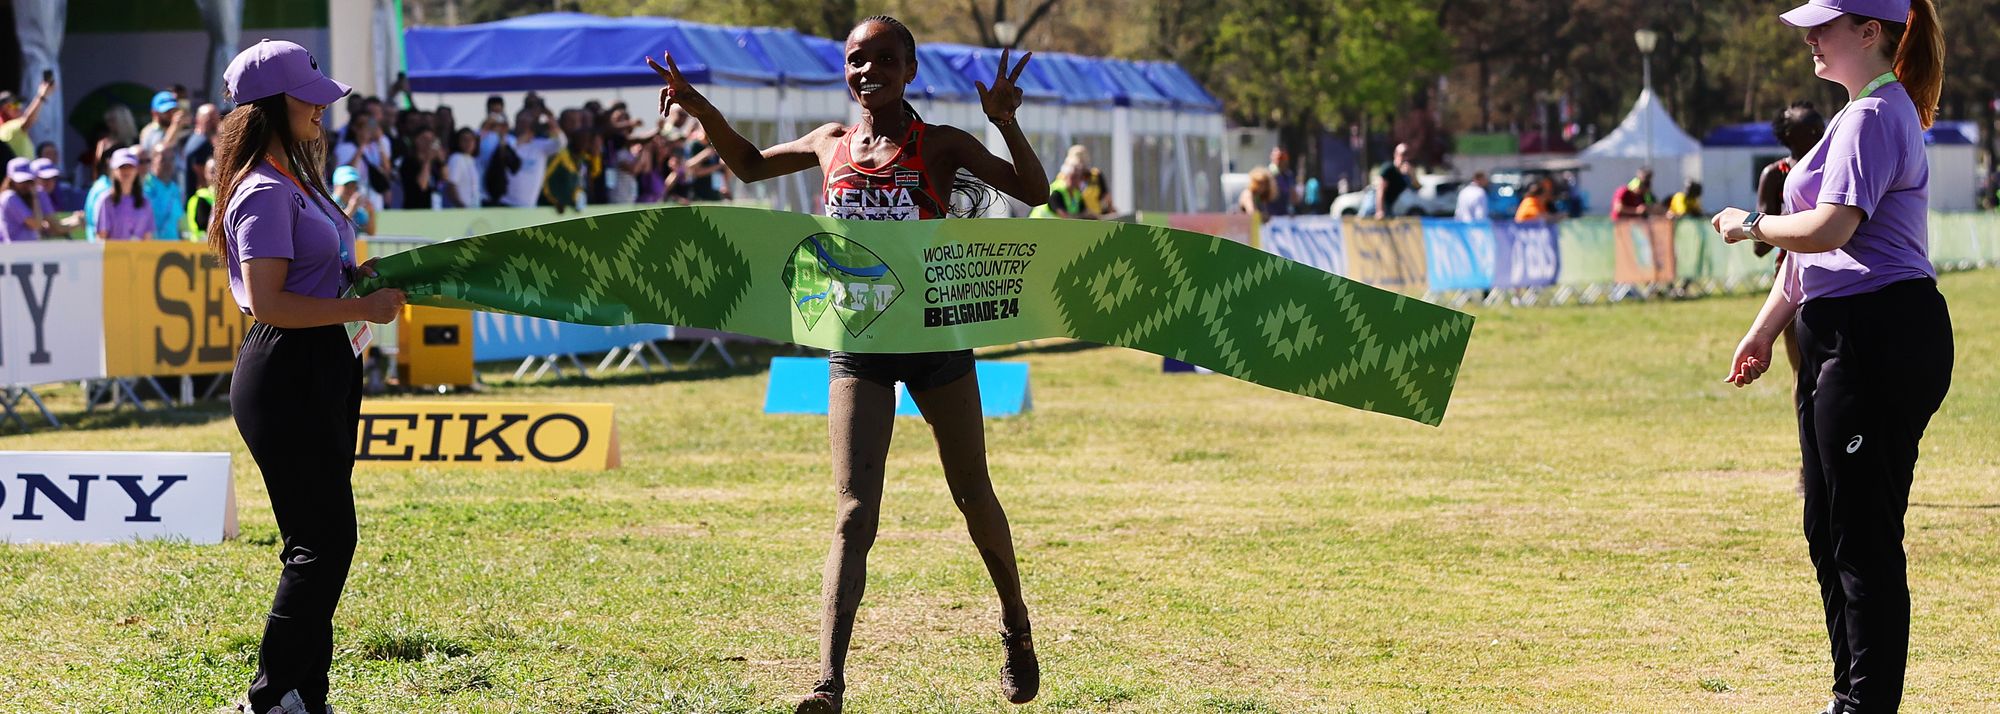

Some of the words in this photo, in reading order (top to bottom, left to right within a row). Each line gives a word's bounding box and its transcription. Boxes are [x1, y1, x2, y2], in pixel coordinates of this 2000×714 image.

[828, 188, 914, 206] KENYA
[923, 243, 964, 263] WORLD
[966, 243, 1037, 258] ATHLETICS
[925, 263, 967, 283] CROSS
[967, 260, 1031, 278] COUNTRY
[925, 278, 1023, 304] CHAMPIONSHIPS
[924, 300, 998, 327] BELGRADE
[1000, 298, 1019, 319] 24
[355, 413, 589, 463] EIKO
[0, 473, 188, 522] NY
